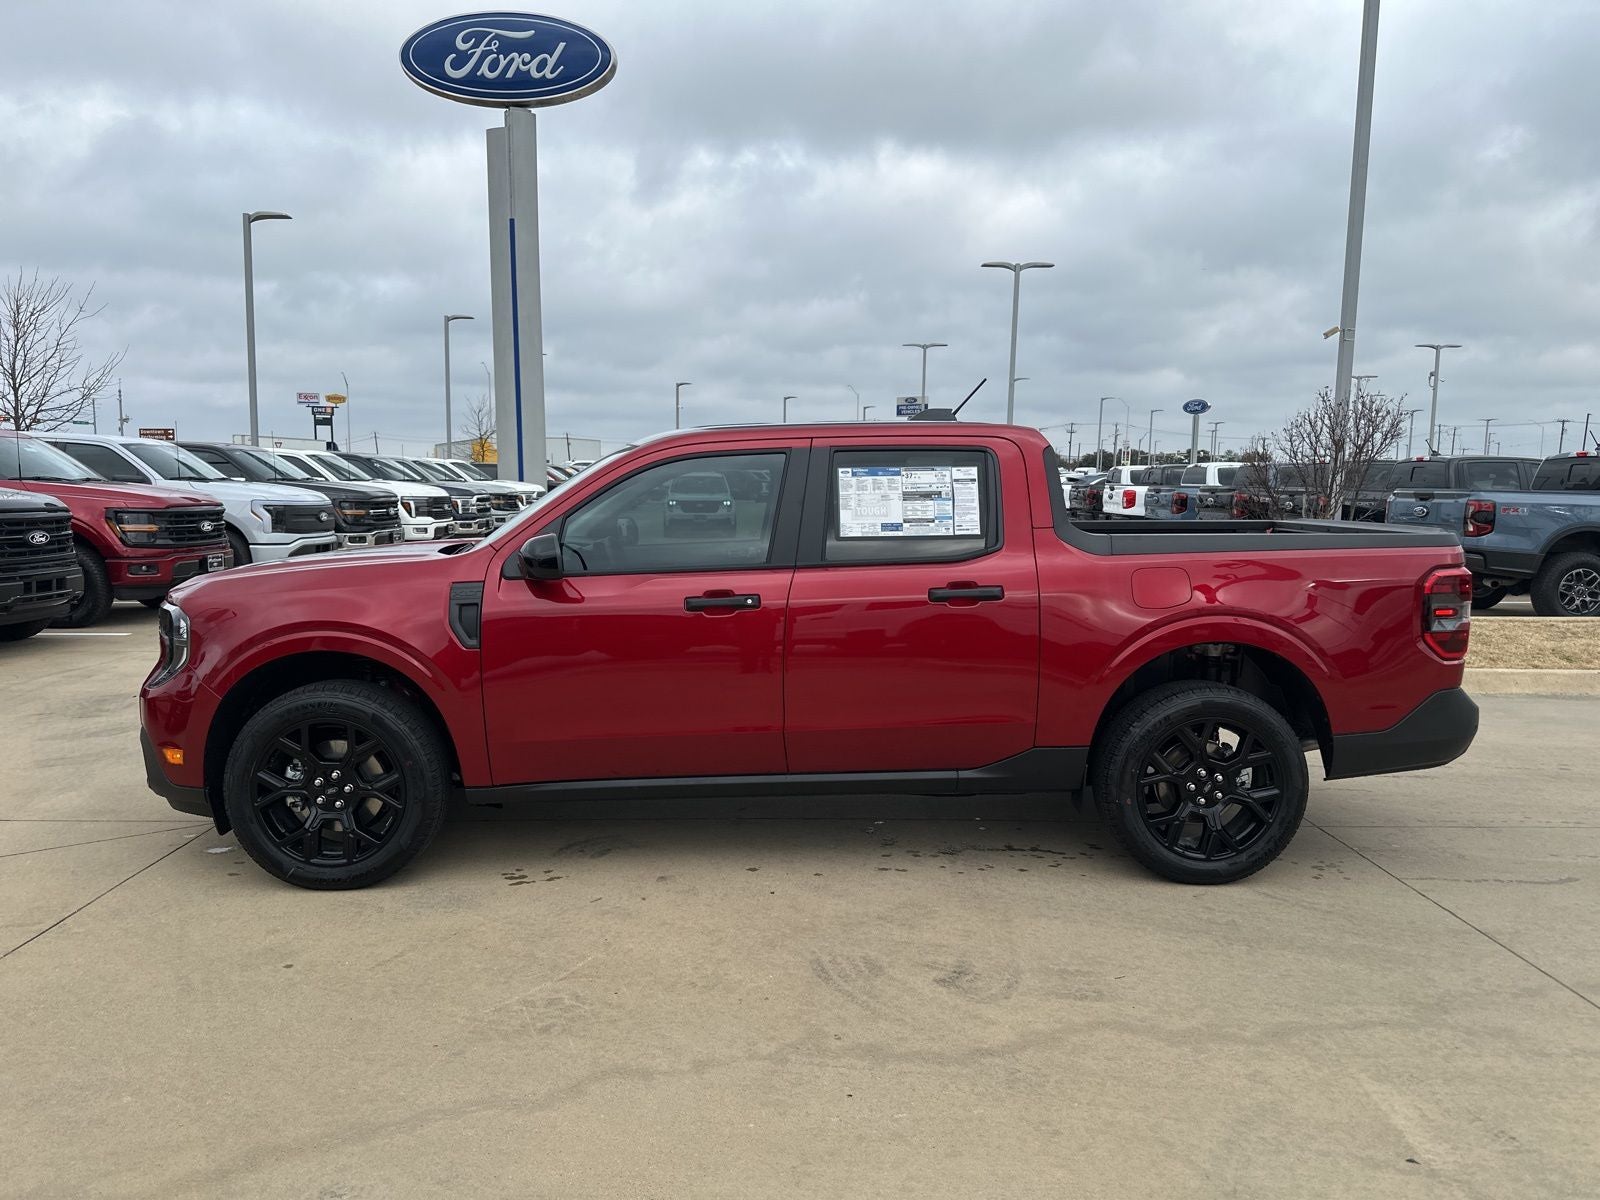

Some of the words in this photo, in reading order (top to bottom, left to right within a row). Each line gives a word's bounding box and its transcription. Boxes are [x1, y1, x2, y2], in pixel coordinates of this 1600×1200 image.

[444, 27, 567, 79] Ford
[298, 393, 319, 401] Exxon
[1186, 401, 1203, 411] Ford
